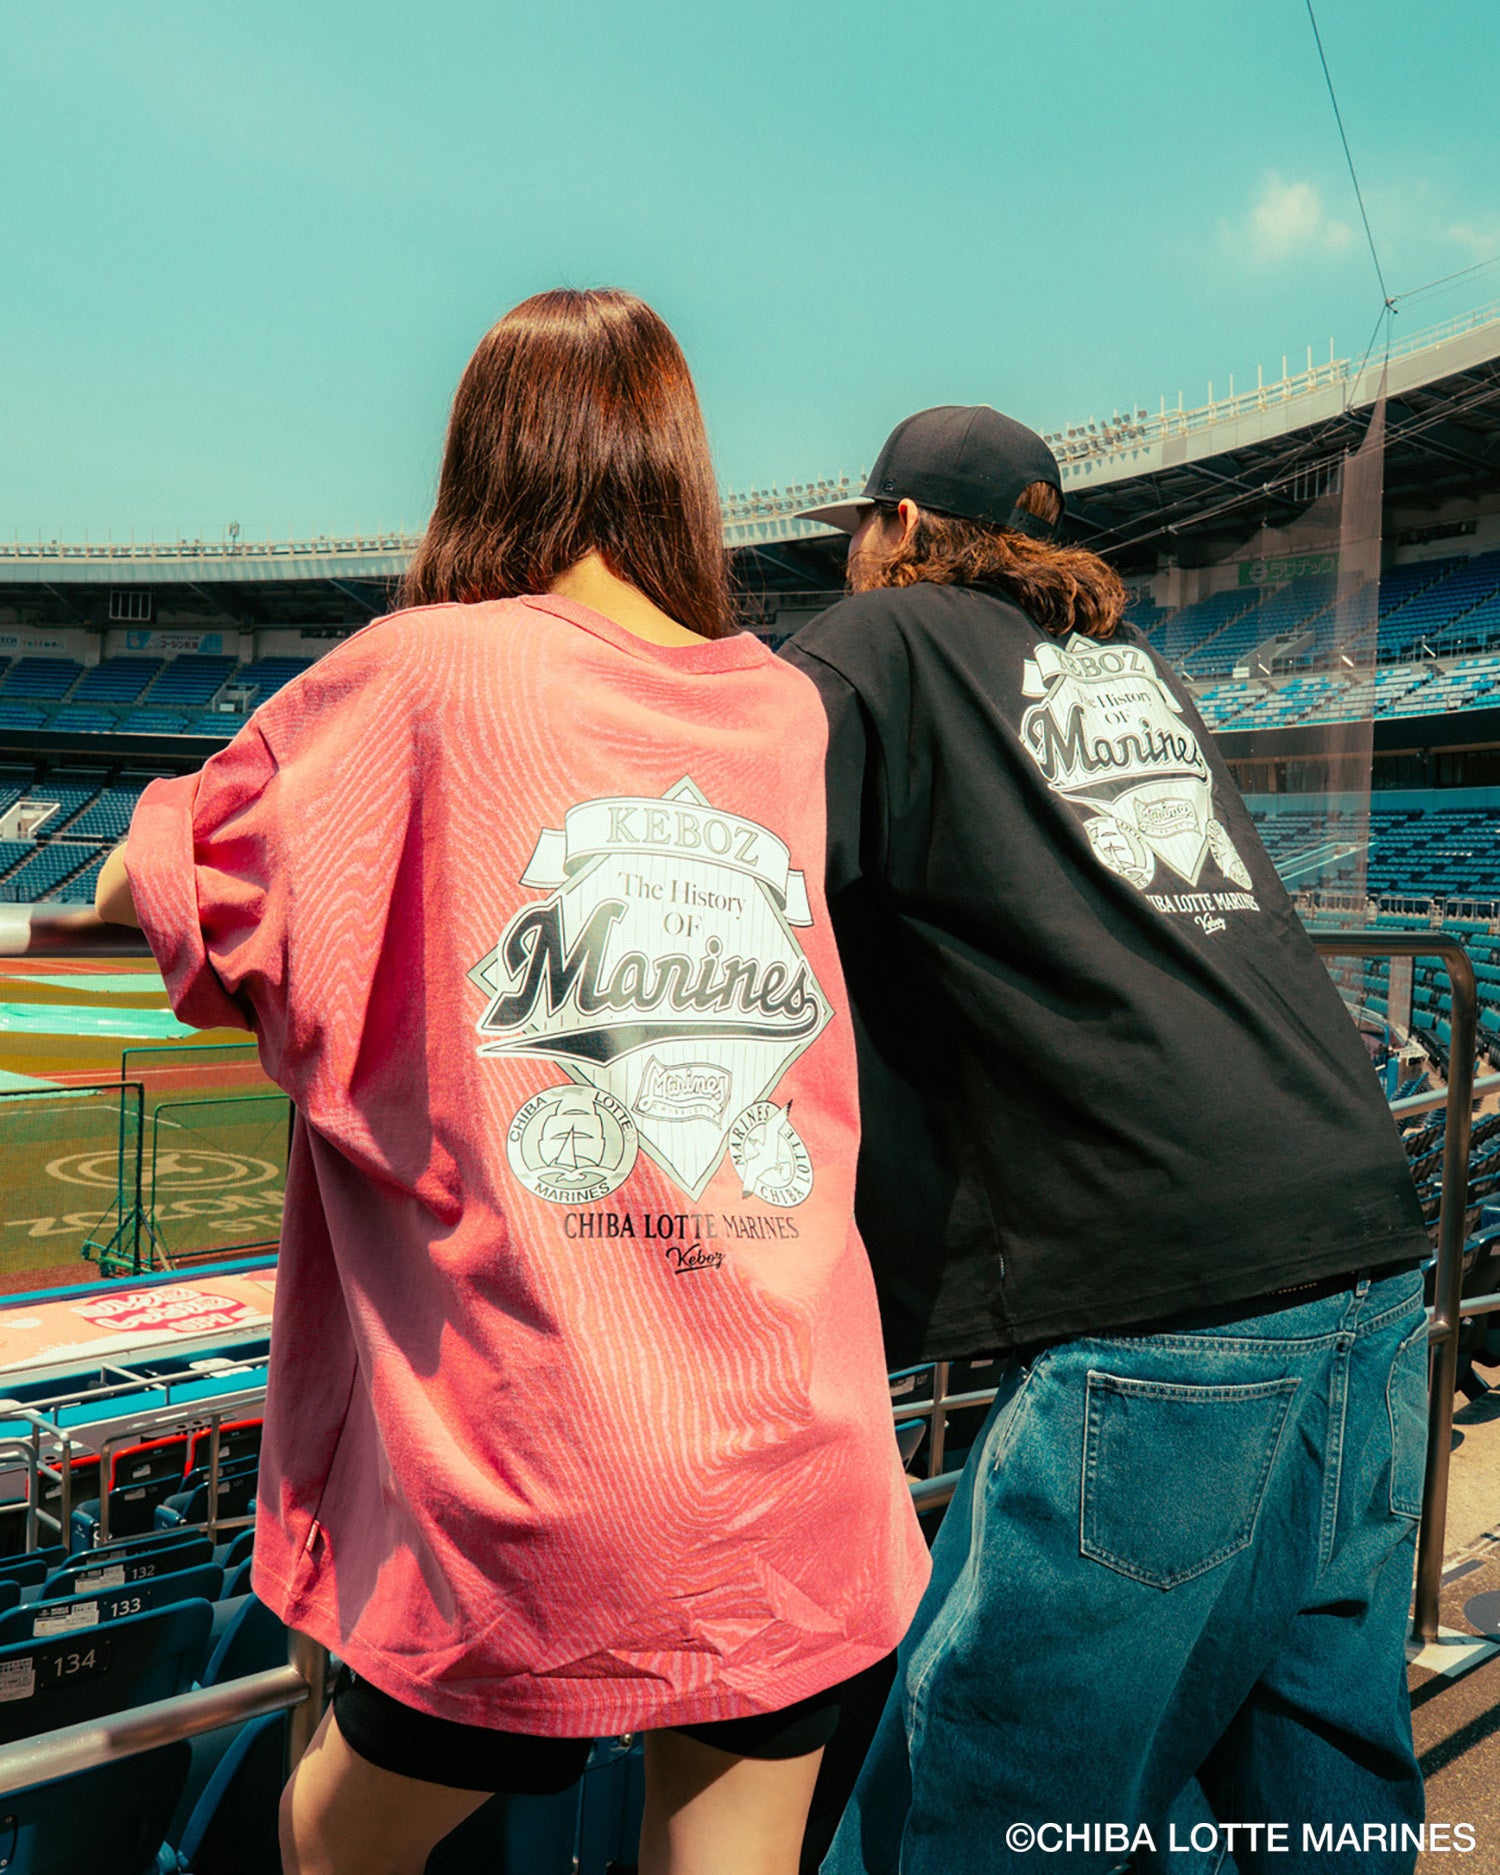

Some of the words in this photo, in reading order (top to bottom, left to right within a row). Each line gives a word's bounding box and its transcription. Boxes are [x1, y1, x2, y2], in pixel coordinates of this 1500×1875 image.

[606, 806, 761, 867] KEBOZ
[618, 872, 663, 900] The
[670, 879, 747, 920] History
[1173, 893, 1216, 913] LOTTE
[662, 911, 704, 938] OF
[476, 896, 821, 1035] Marines
[643, 1064, 727, 1101] Marines
[509, 1096, 548, 1142] CHIBA
[594, 1091, 633, 1130] LOTTE
[730, 1104, 771, 1167] MARINES
[534, 1182, 610, 1202] MARINES
[760, 1185, 805, 1204] CHIBA
[564, 1212, 635, 1239] CHIBA
[644, 1213, 718, 1239] LOTTE
[722, 1214, 800, 1240] MARINES
[665, 1243, 727, 1275] Keboz
[131, 1564, 156, 1581] 132
[110, 1597, 142, 1618] 133
[53, 1649, 97, 1678] 134
